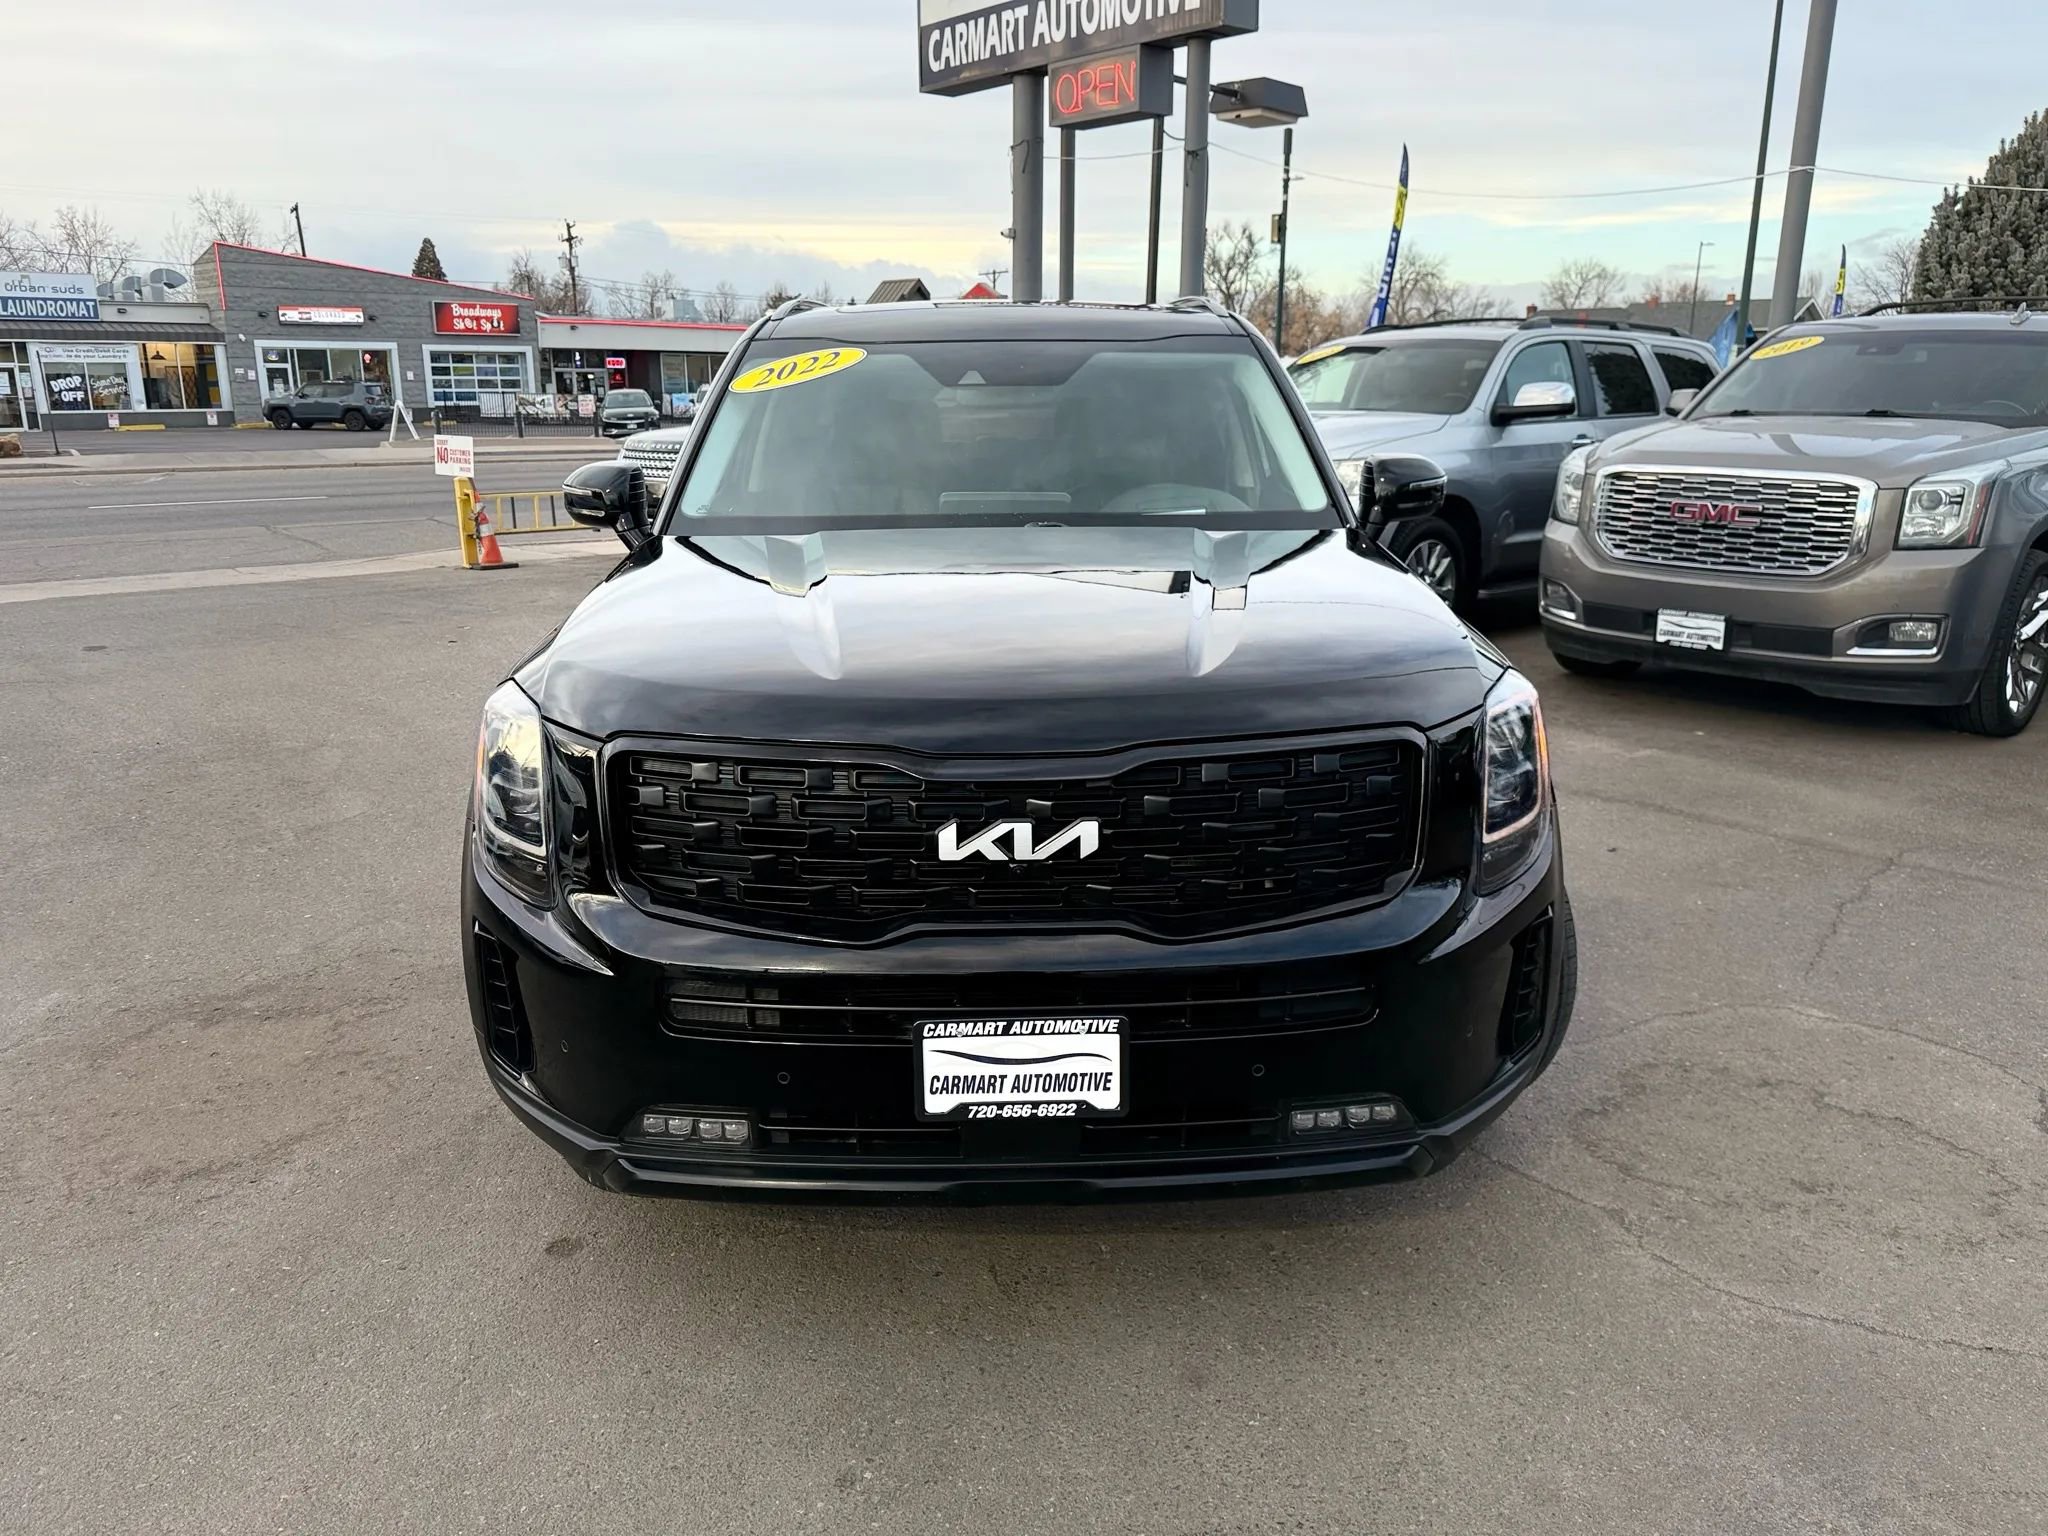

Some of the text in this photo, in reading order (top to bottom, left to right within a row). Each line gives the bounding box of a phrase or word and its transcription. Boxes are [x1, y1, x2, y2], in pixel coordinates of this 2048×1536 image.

[928, 0, 1200, 72] CARMART AUTOMO
[1055, 60, 1137, 113] OPEN
[51, 284, 84, 294] suds
[0, 299, 95, 317] LAUNDROMAT
[752, 351, 841, 388] 2022
[49, 375, 82, 392] DROP
[61, 391, 85, 402] OFF
[437, 446, 449, 464] NO
[449, 457, 472, 465] PARKING
[1670, 500, 1763, 527] GMC
[937, 819, 1100, 861] KIA
[923, 1019, 1120, 1037] CARMART AUTOMOTIVE
[929, 1072, 1113, 1095] CARMART AUTOMOTIVE
[967, 1103, 1077, 1118] 720-656-6922
